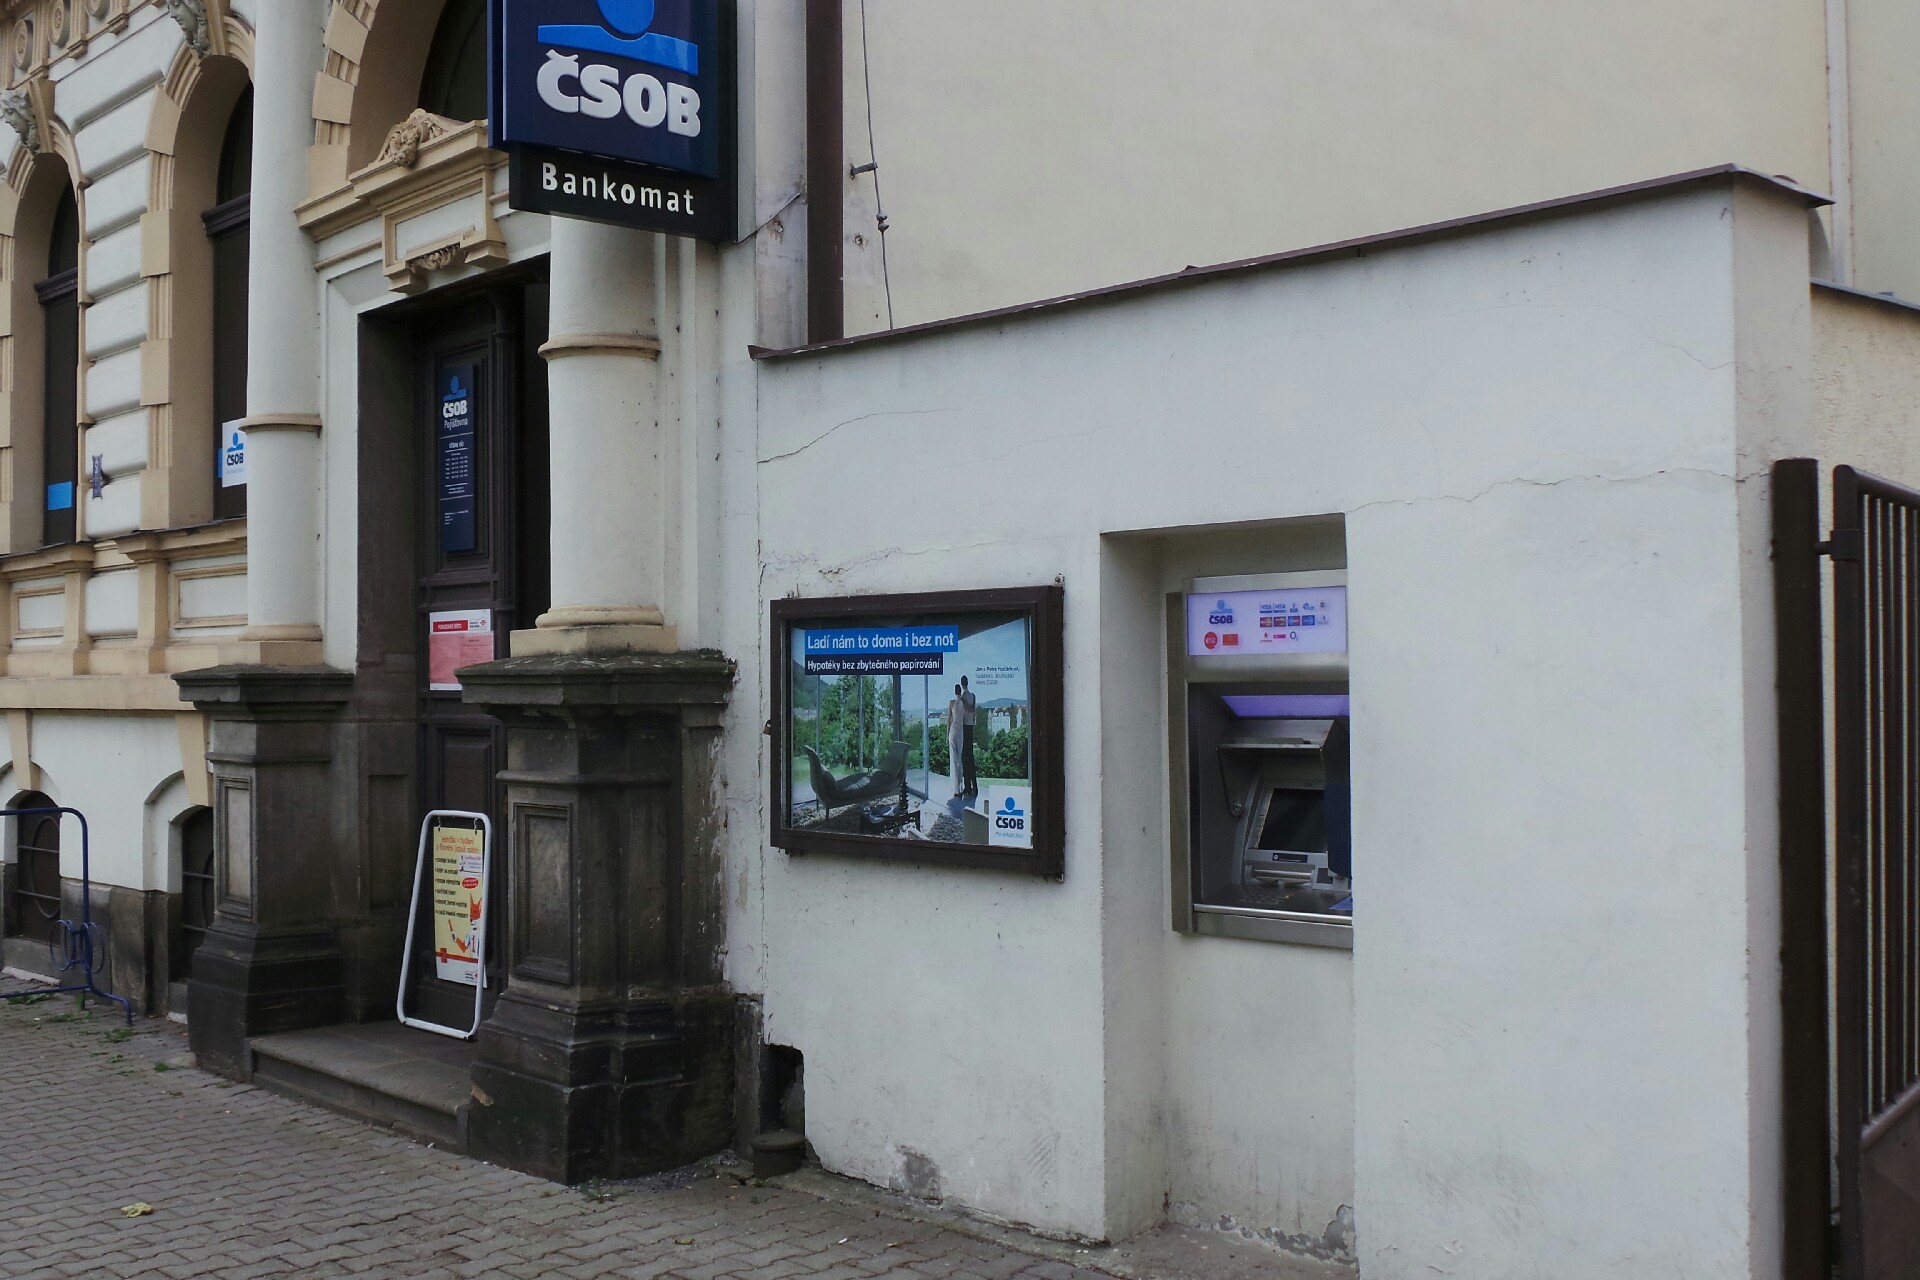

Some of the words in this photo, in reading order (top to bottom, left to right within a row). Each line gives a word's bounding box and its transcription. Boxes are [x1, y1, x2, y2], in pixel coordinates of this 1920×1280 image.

[536, 49, 701, 138] ČSOB
[542, 161, 695, 215] Bankomat
[443, 400, 468, 418] ČSOB
[1208, 614, 1233, 624] ČSOB
[807, 634, 830, 650] Ladí
[832, 634, 855, 649] nám
[858, 634, 869, 648] to
[871, 633, 902, 648] doma
[905, 633, 909, 648] i
[911, 633, 932, 647] bez
[935, 632, 954, 646] not
[807, 659, 841, 672] Hypotéky
[842, 659, 855, 670] bez
[856, 659, 899, 671] zbytečného
[900, 658, 940, 671] papírování
[995, 815, 1024, 830] ČSOB
